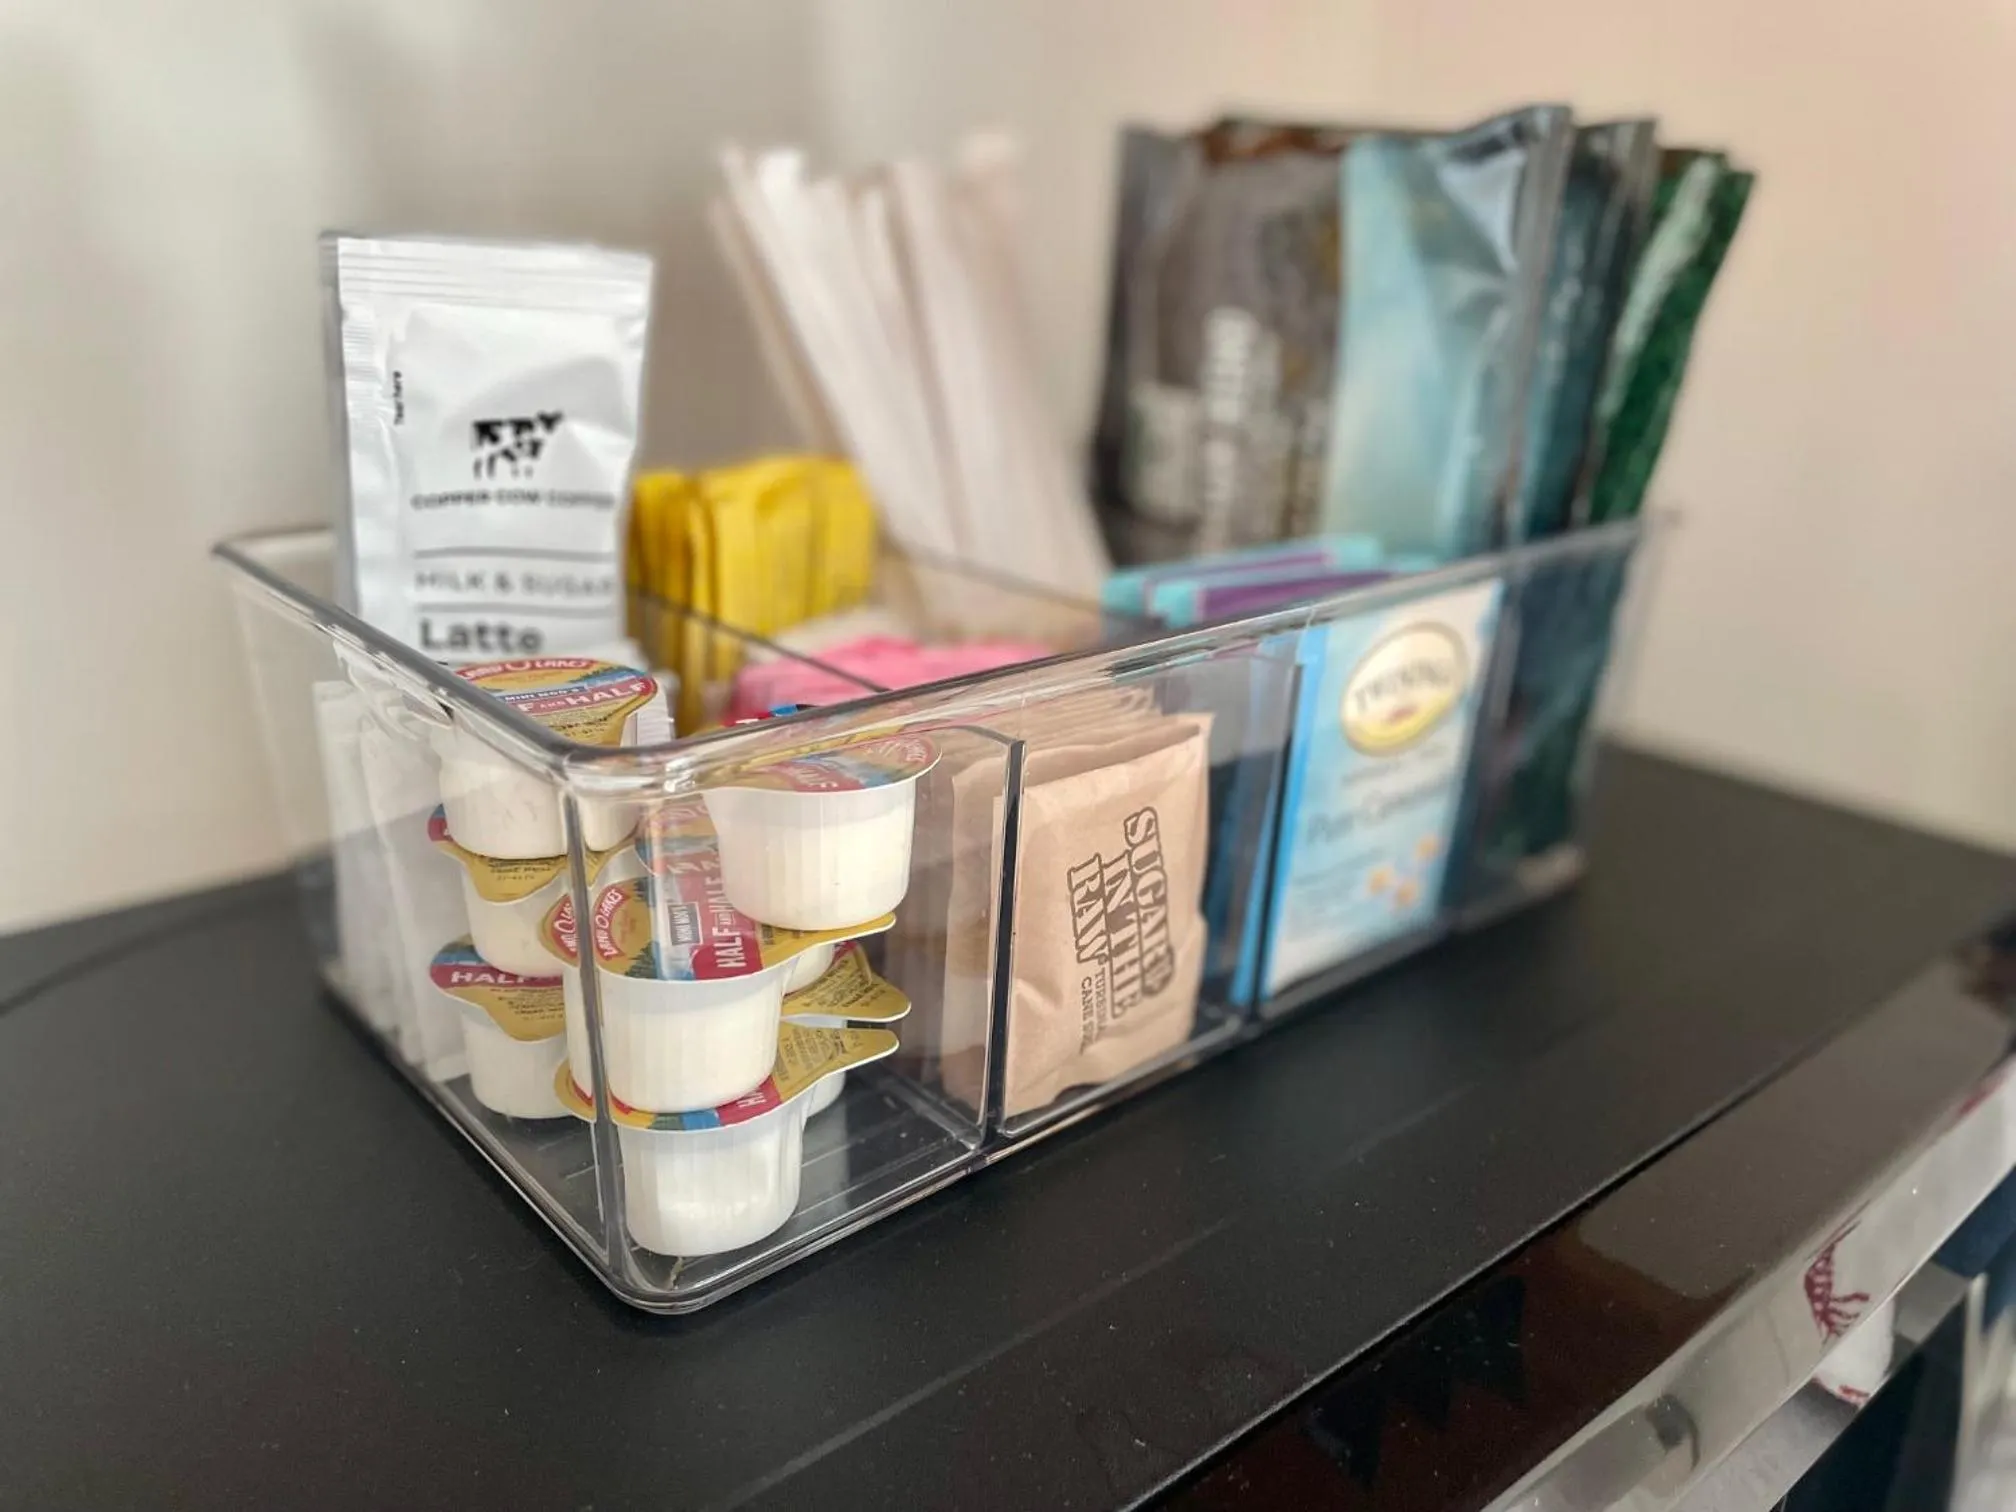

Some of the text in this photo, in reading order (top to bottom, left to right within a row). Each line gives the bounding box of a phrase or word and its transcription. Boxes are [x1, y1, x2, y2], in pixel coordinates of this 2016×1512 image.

[496, 488, 540, 507] COW
[415, 571, 486, 593] MILK
[493, 571, 514, 595] &
[566, 680, 647, 706] HALF
[1067, 853, 1109, 963] RAW
[711, 927, 747, 968] HALF
[1103, 849, 1145, 1020] IN THE
